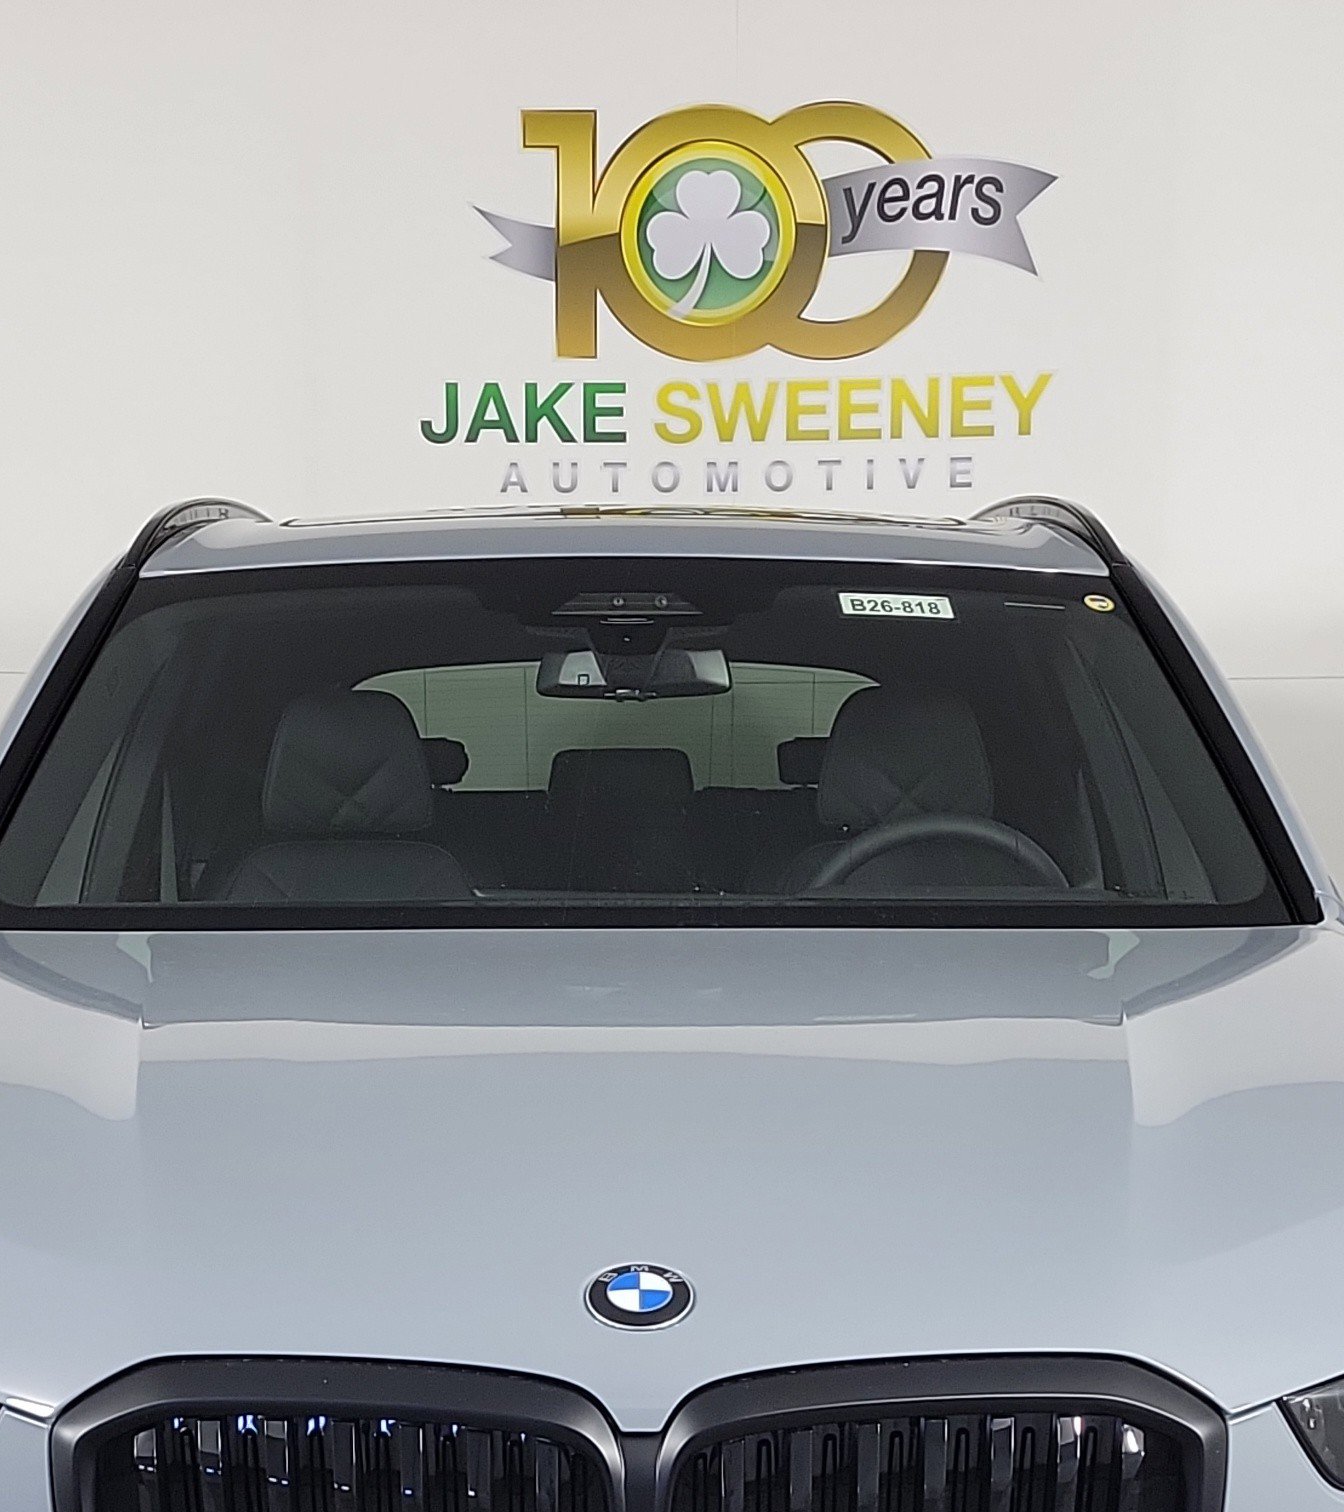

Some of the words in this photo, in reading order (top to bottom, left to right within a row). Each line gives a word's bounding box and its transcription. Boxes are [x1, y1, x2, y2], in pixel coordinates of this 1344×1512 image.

[840, 169, 1004, 243] years
[420, 381, 628, 444] JAKE
[654, 372, 1052, 444] SWEENEY
[500, 456, 974, 494] AUTOMOTIVE
[850, 598, 941, 615] B26-818
